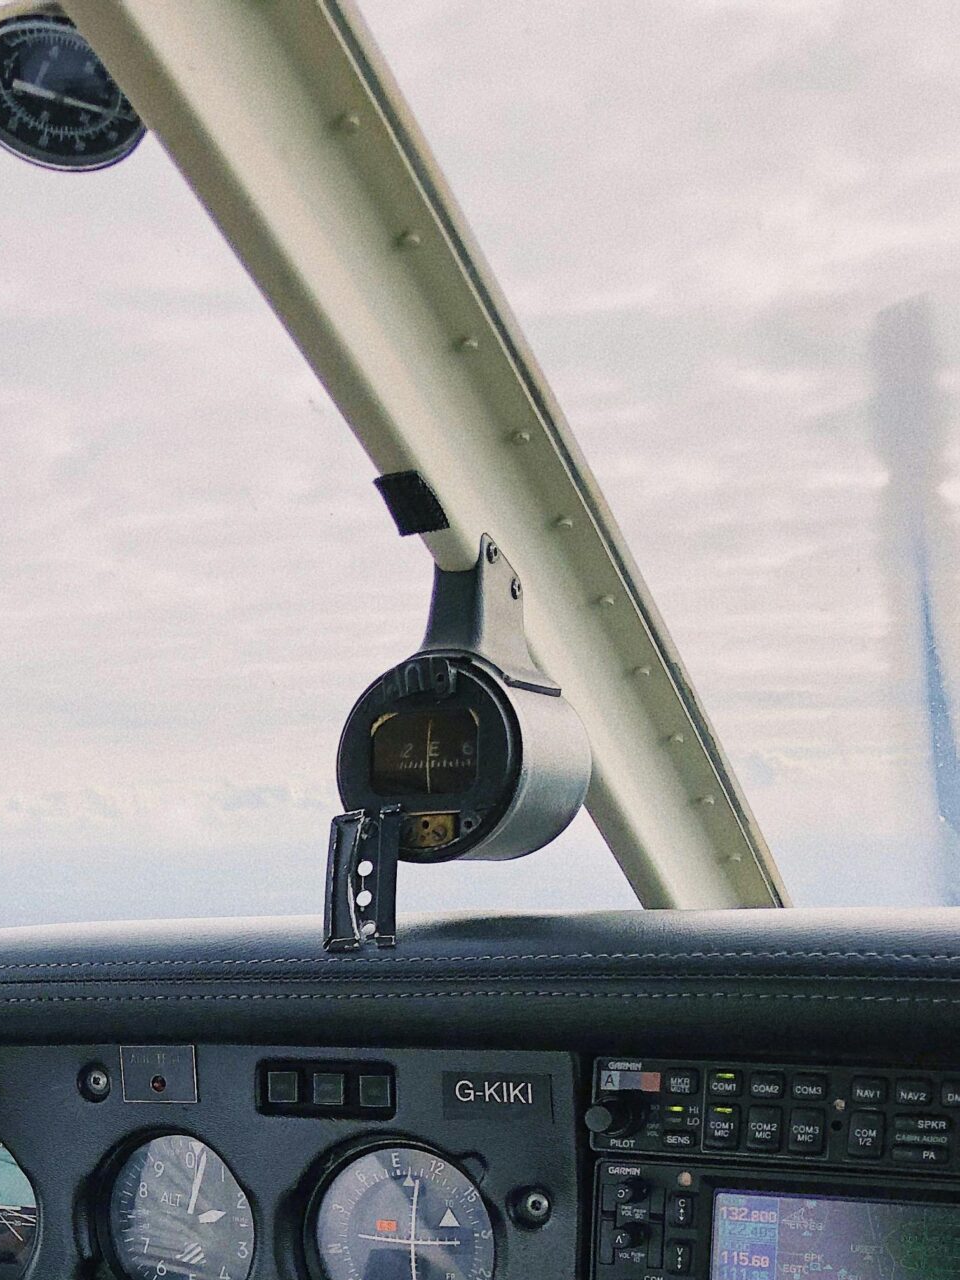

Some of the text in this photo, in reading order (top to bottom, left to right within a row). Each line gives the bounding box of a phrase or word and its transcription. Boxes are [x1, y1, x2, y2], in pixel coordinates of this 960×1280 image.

[608, 1062, 642, 1071] GARMIN
[711, 1082, 736, 1092] COM1
[752, 1084, 780, 1093] COM2
[795, 1086, 822, 1095] COM3
[455, 1080, 532, 1104] G-KIKI
[856, 1089, 880, 1099] NAV1
[900, 1091, 927, 1101] NAV2
[690, 1106, 700, 1114] HI
[687, 1117, 700, 1126] LO
[917, 1120, 946, 1130] SPKR
[750, 1123, 777, 1132] COM2
[792, 1125, 820, 1134] COM3
[714, 1130, 730, 1138] MIC
[755, 1131, 772, 1139] MIC
[854, 1129, 877, 1137] COM
[666, 1136, 690, 1145] SENS
[797, 1134, 814, 1142] MIC
[859, 1138, 872, 1146] 1/2
[610, 1139, 636, 1148] PILOT
[922, 1151, 936, 1160] PA
[608, 1166, 641, 1176] GARMIN
[160, 1192, 182, 1206] ALT
